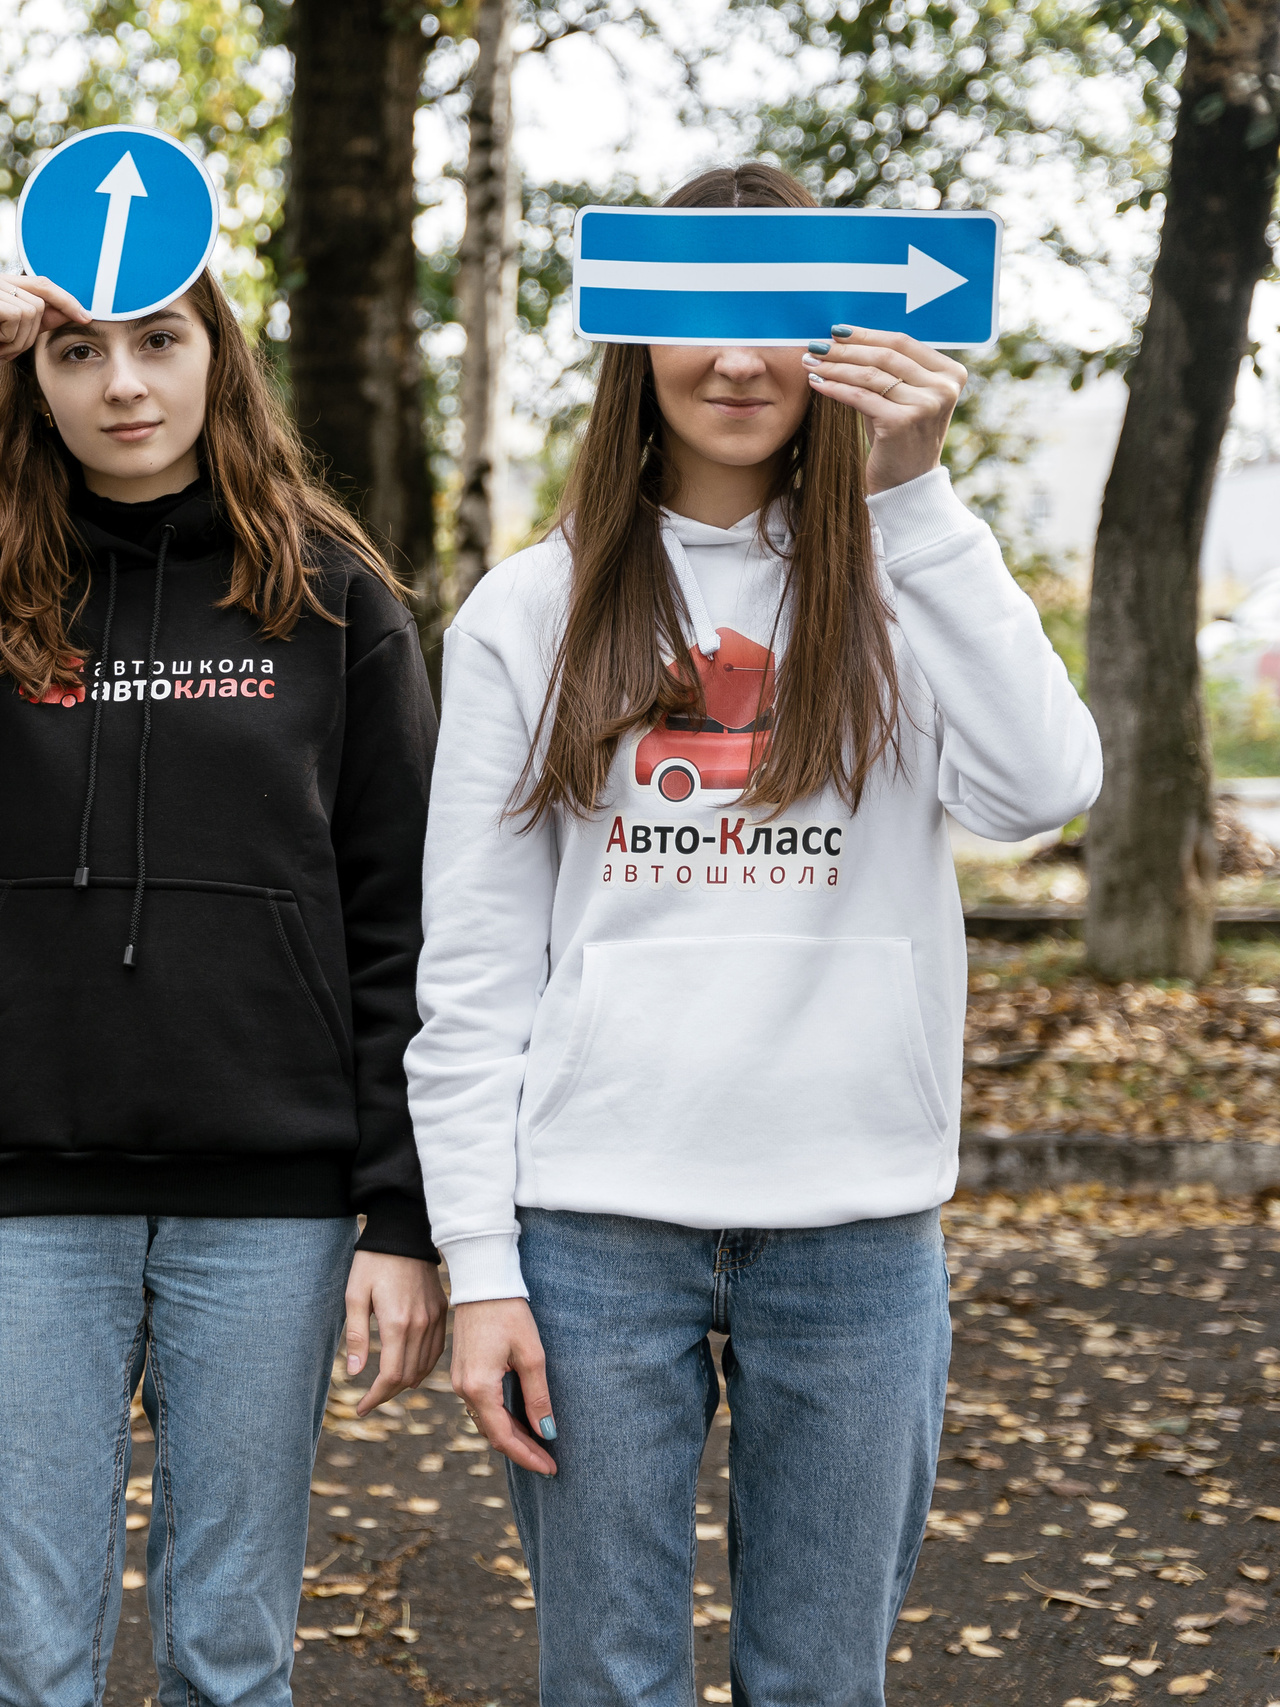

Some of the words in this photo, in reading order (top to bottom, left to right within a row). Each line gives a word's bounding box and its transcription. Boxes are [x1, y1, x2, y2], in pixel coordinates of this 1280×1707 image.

[91, 678, 275, 702] автокласс
[605, 816, 842, 856] Авто-Класс
[602, 863, 839, 886] автошкола
